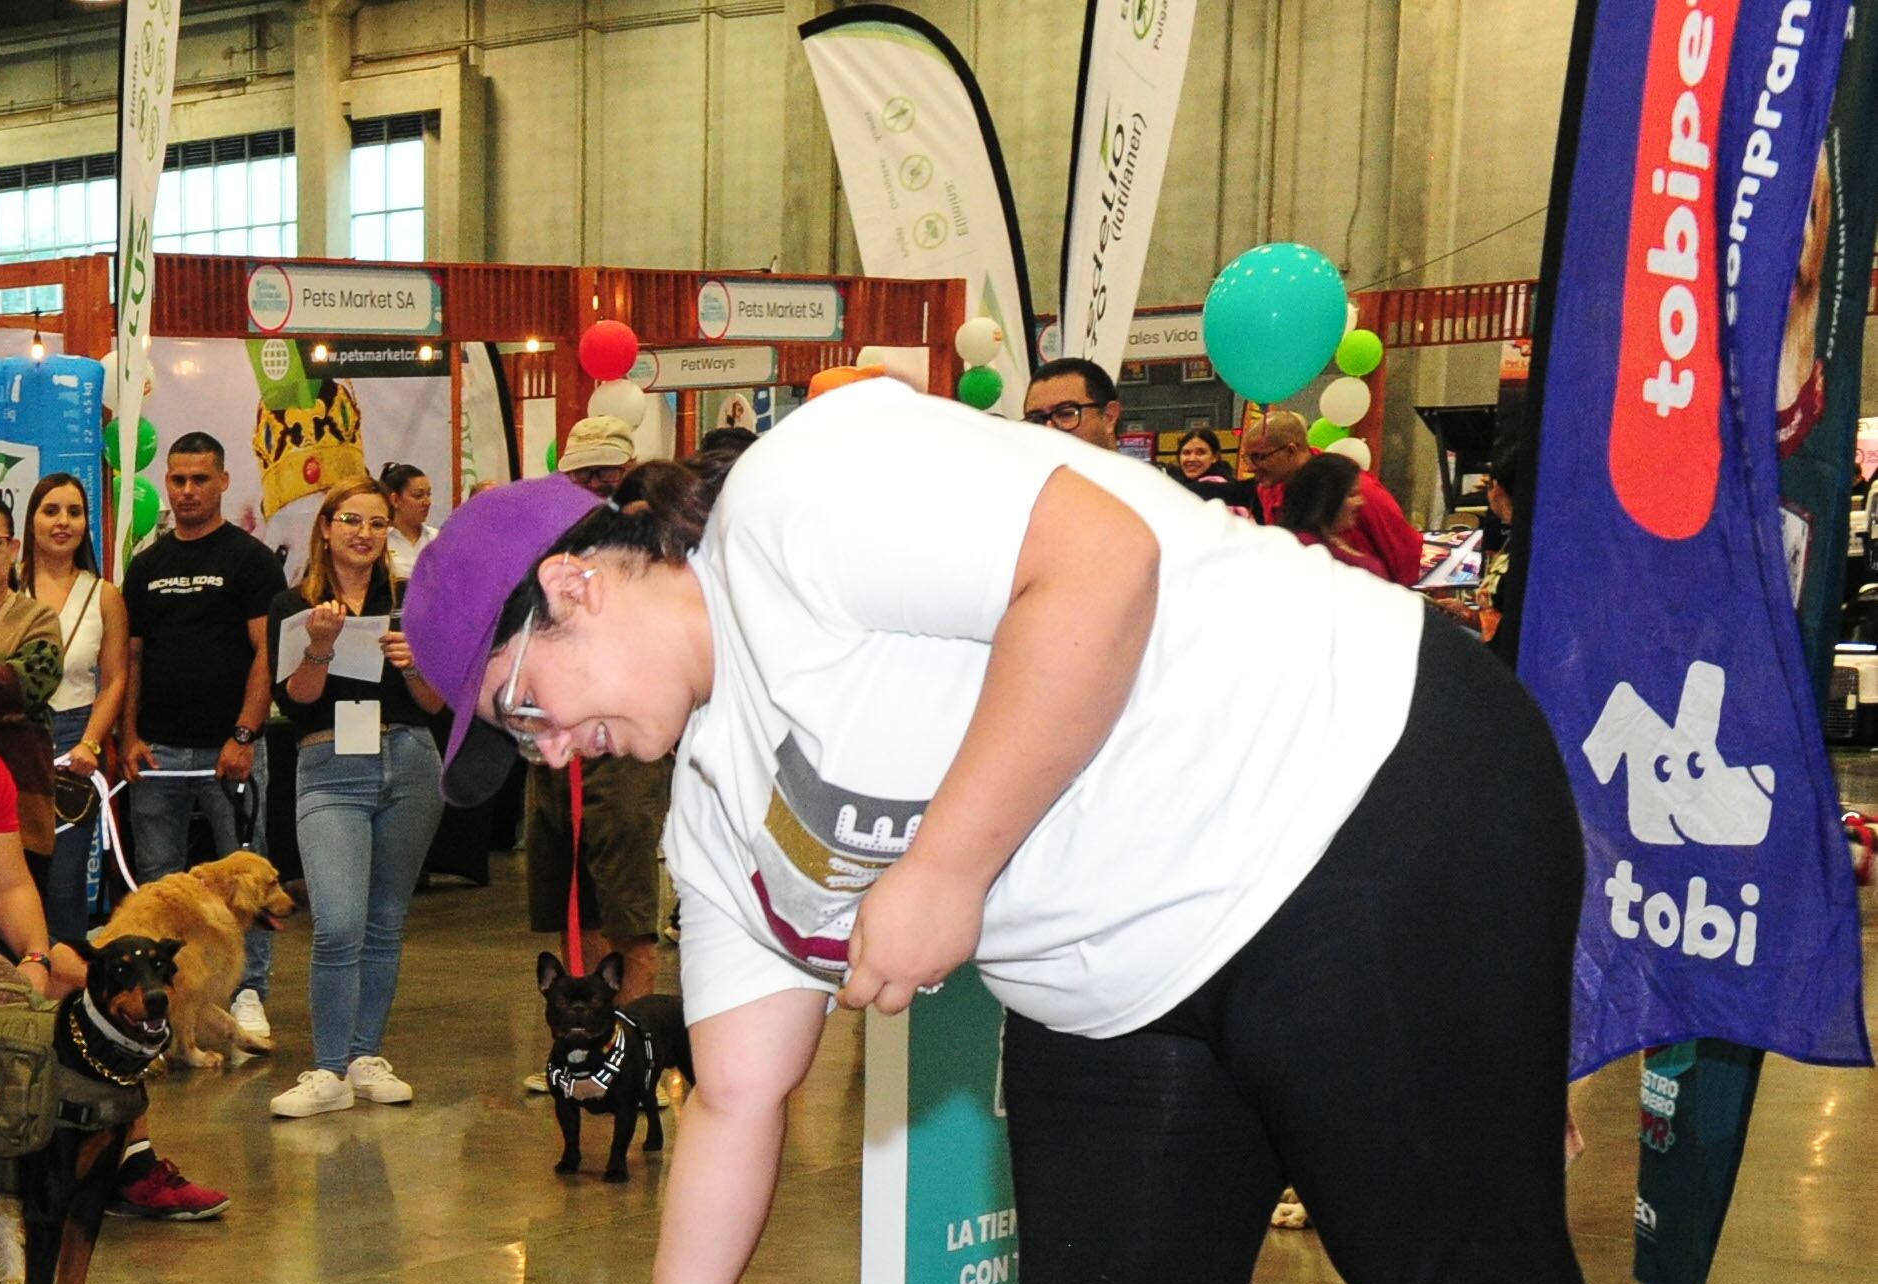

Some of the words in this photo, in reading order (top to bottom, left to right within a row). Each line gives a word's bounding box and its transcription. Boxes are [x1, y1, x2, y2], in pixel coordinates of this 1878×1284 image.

[1112, 112, 1148, 241] (lotilaner)
[1643, 0, 1714, 417] tobipe
[302, 288, 336, 309] Pets
[340, 289, 392, 309] Market
[396, 291, 415, 309] SA
[738, 300, 763, 318] Pets
[766, 301, 807, 319] Market
[809, 302, 824, 319] SA
[1163, 328, 1199, 343] Vida
[681, 356, 736, 373] PetWays
[192, 575, 224, 587] KORS
[1604, 859, 1761, 967] tobi
[947, 1219, 974, 1251] LA
